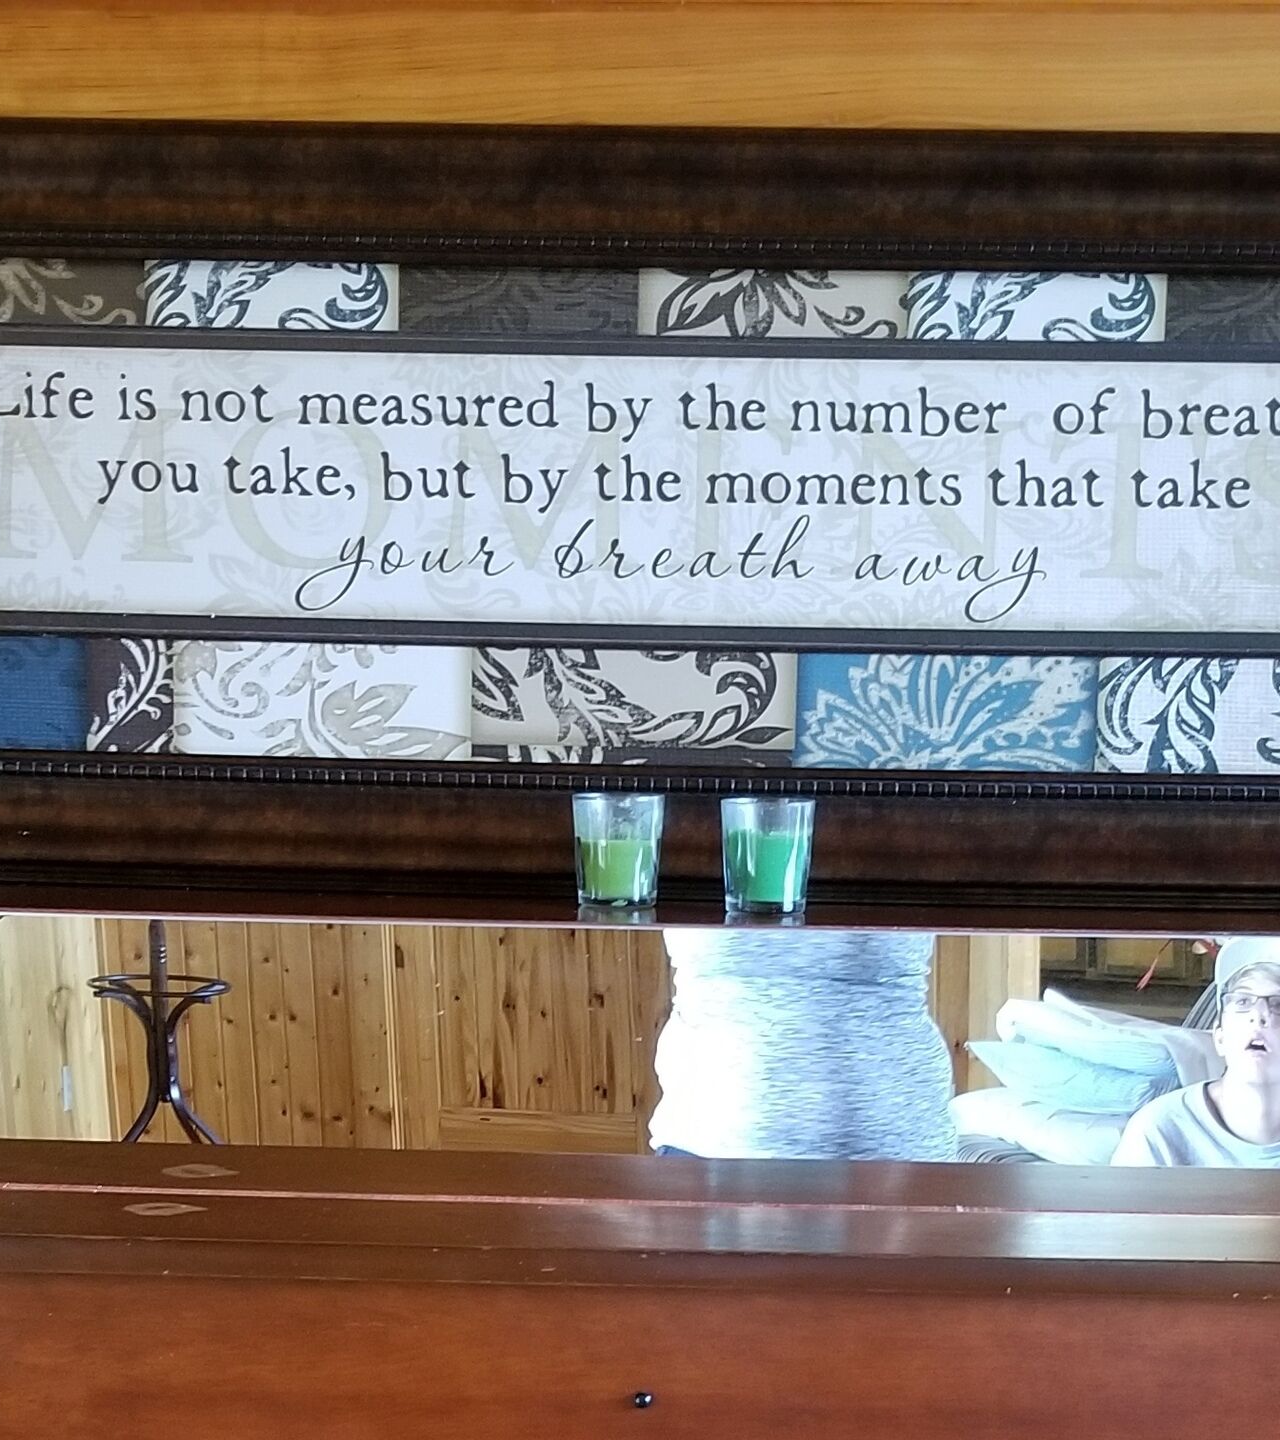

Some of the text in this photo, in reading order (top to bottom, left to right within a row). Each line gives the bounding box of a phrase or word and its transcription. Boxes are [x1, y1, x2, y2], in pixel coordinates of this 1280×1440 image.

[118, 373, 157, 421] is
[181, 384, 274, 423] not
[298, 380, 559, 428] measured
[585, 382, 652, 442] by
[678, 382, 768, 431] the
[790, 386, 1006, 434] number
[1053, 387, 1116, 436] of
[97, 446, 1251, 514] you take, but by the moments that take
[295, 514, 1046, 623] your breath away
